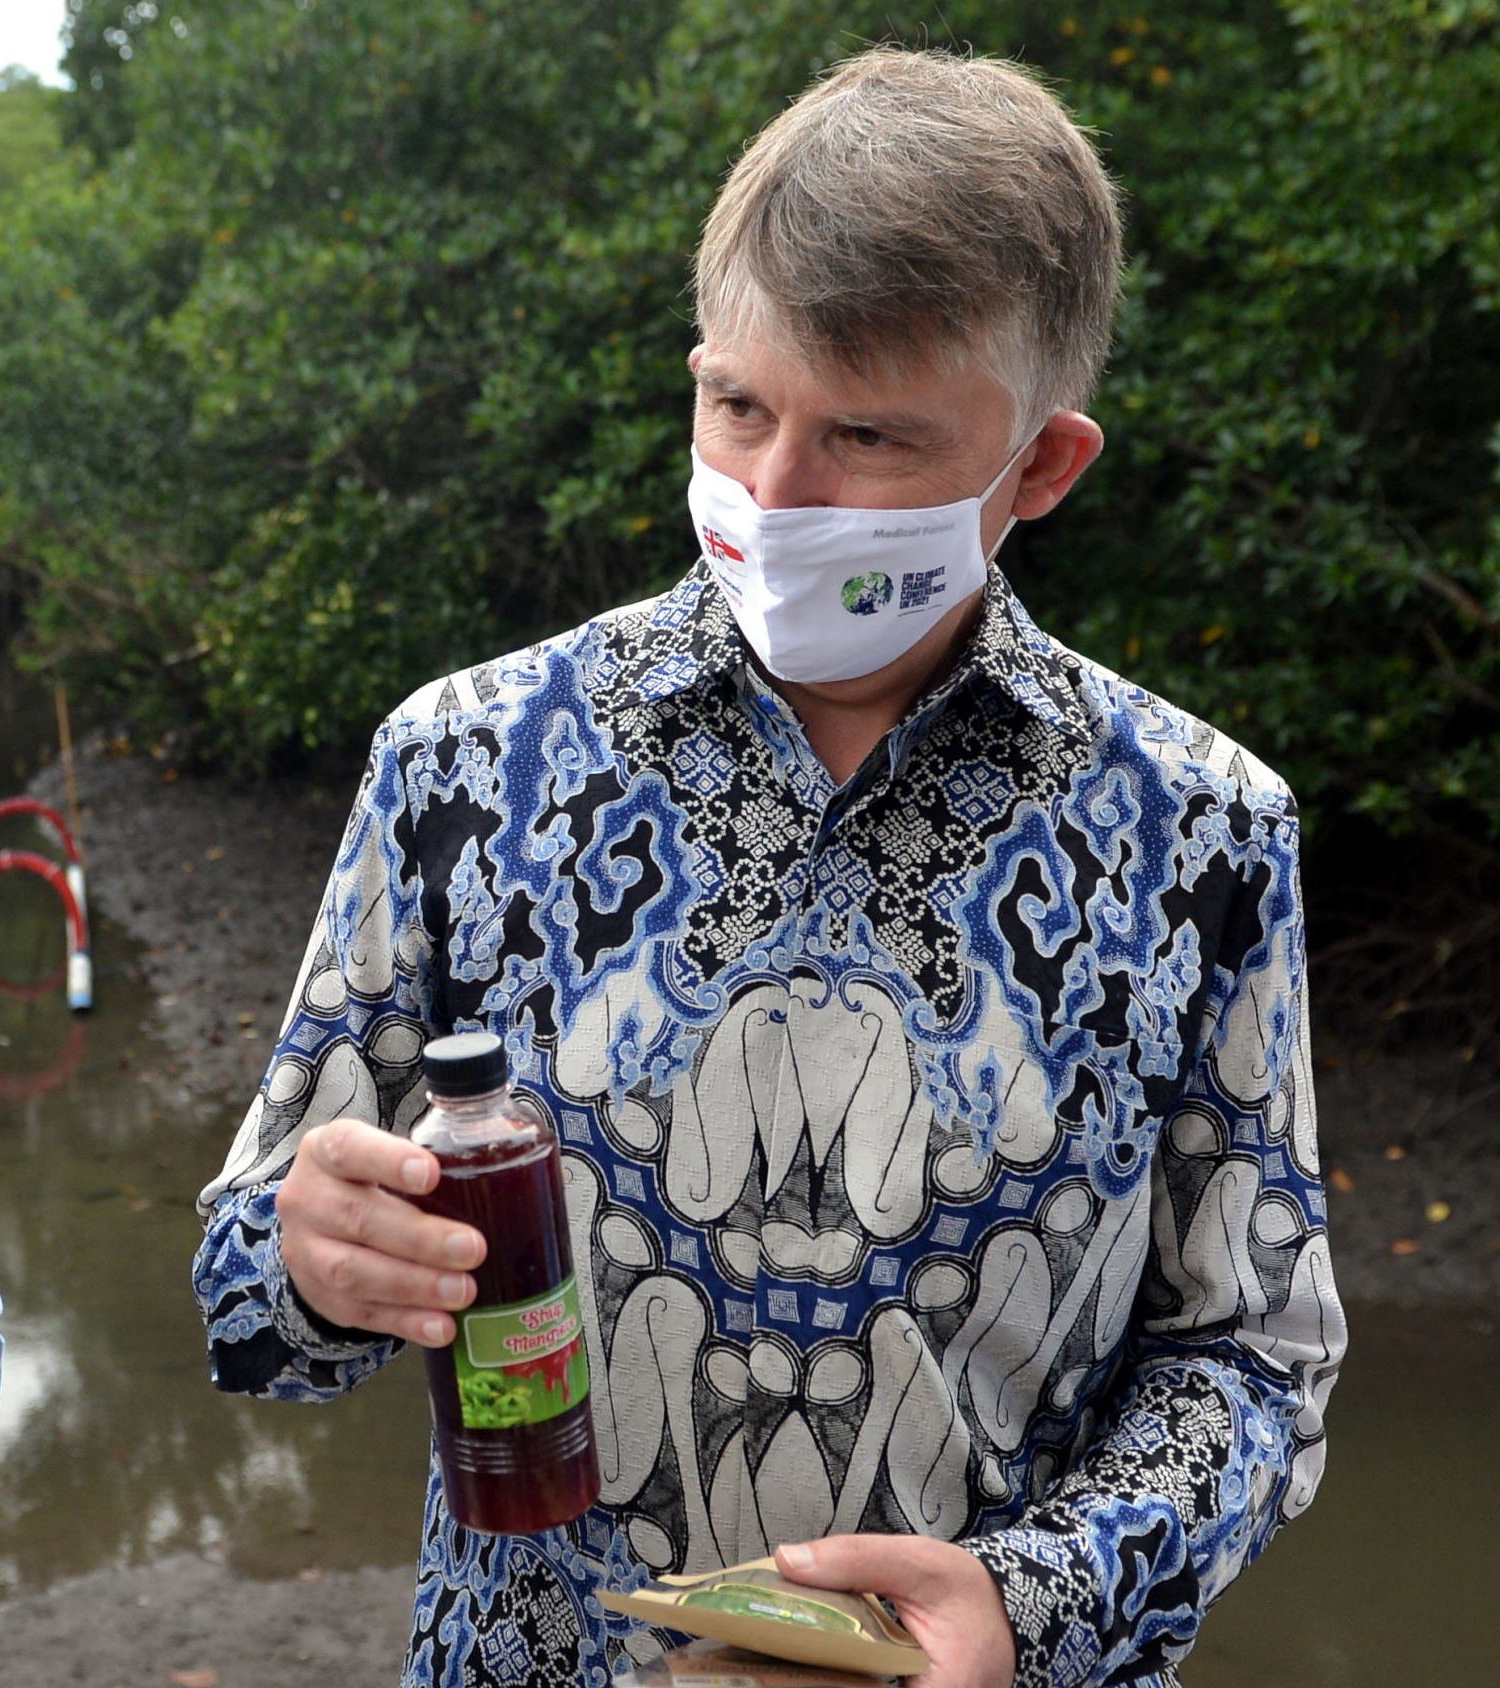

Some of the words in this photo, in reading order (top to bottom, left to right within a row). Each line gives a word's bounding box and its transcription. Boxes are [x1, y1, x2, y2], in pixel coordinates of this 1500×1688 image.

[902, 573, 914, 582] UN
[915, 565, 946, 582] CLIMATE
[900, 583, 946, 600] CONFERENCE
[901, 578, 932, 592] CHANGE
[899, 600, 910, 609] UK
